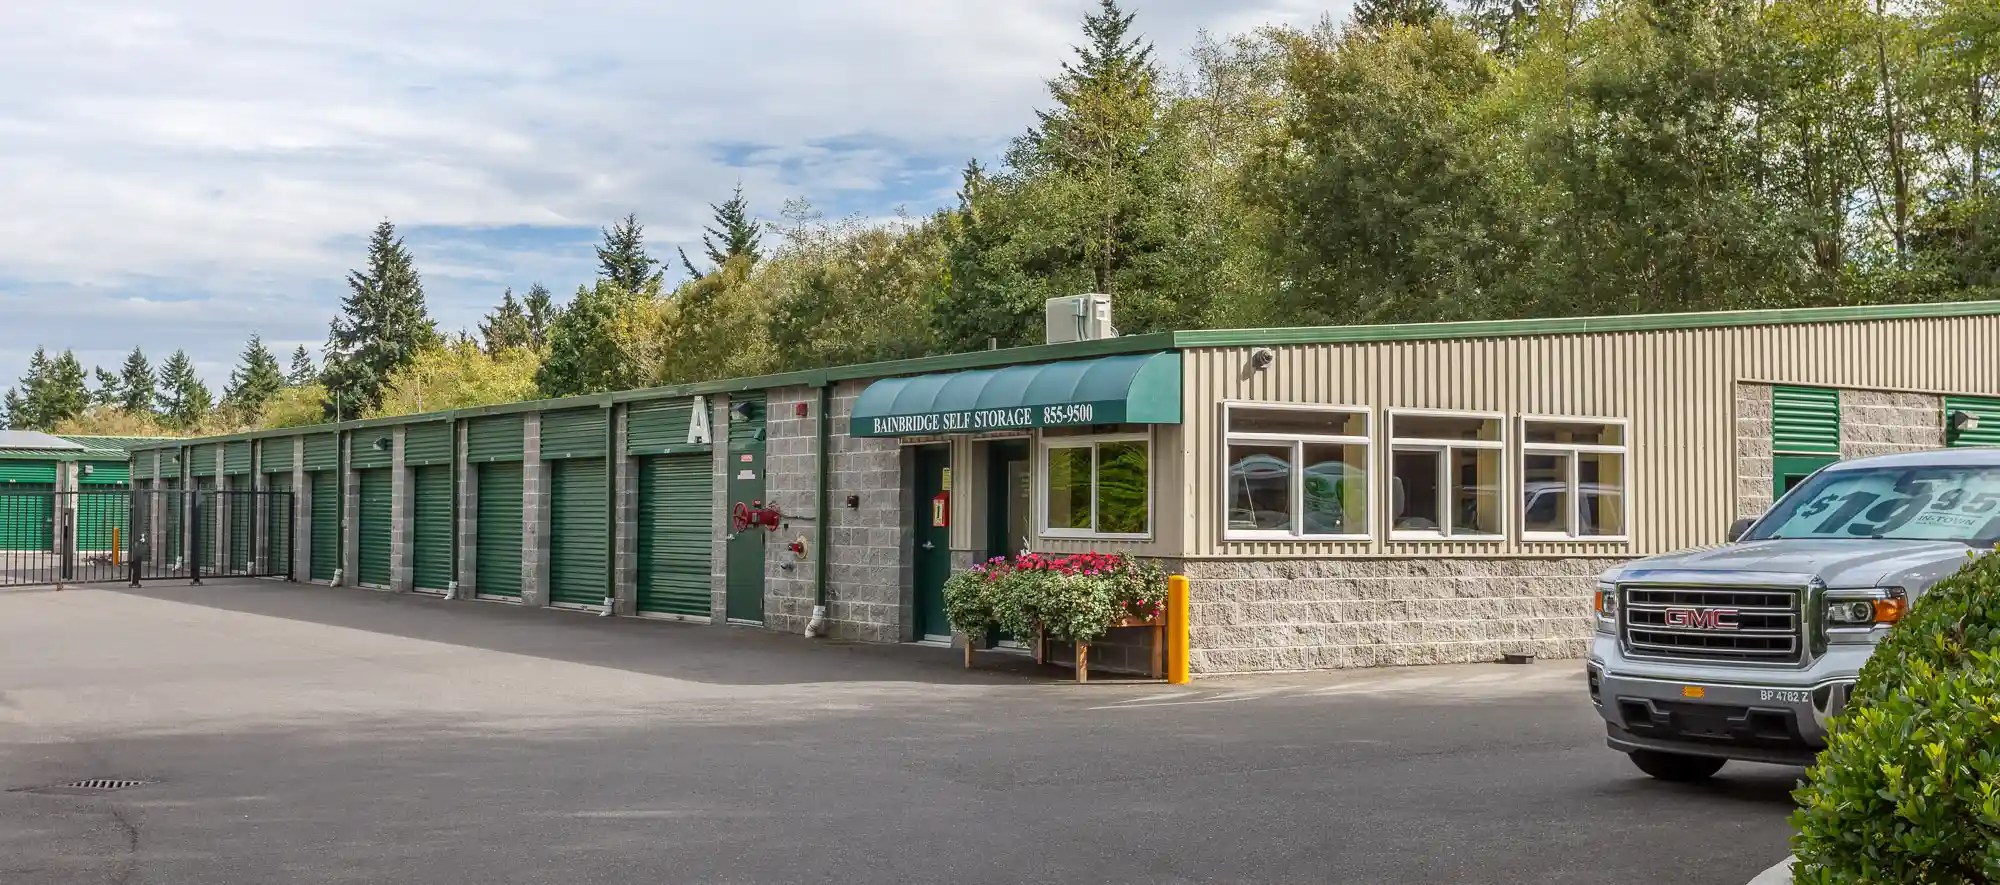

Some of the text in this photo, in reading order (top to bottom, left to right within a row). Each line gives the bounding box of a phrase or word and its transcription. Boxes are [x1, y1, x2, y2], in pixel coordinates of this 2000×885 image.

[687, 395, 712, 443] A
[873, 404, 1093, 434] BAINBRIDGE SELF STORAGE 855-9500
[1664, 607, 1739, 630] GMC
[1760, 690, 1809, 702] BP 4782 Z
